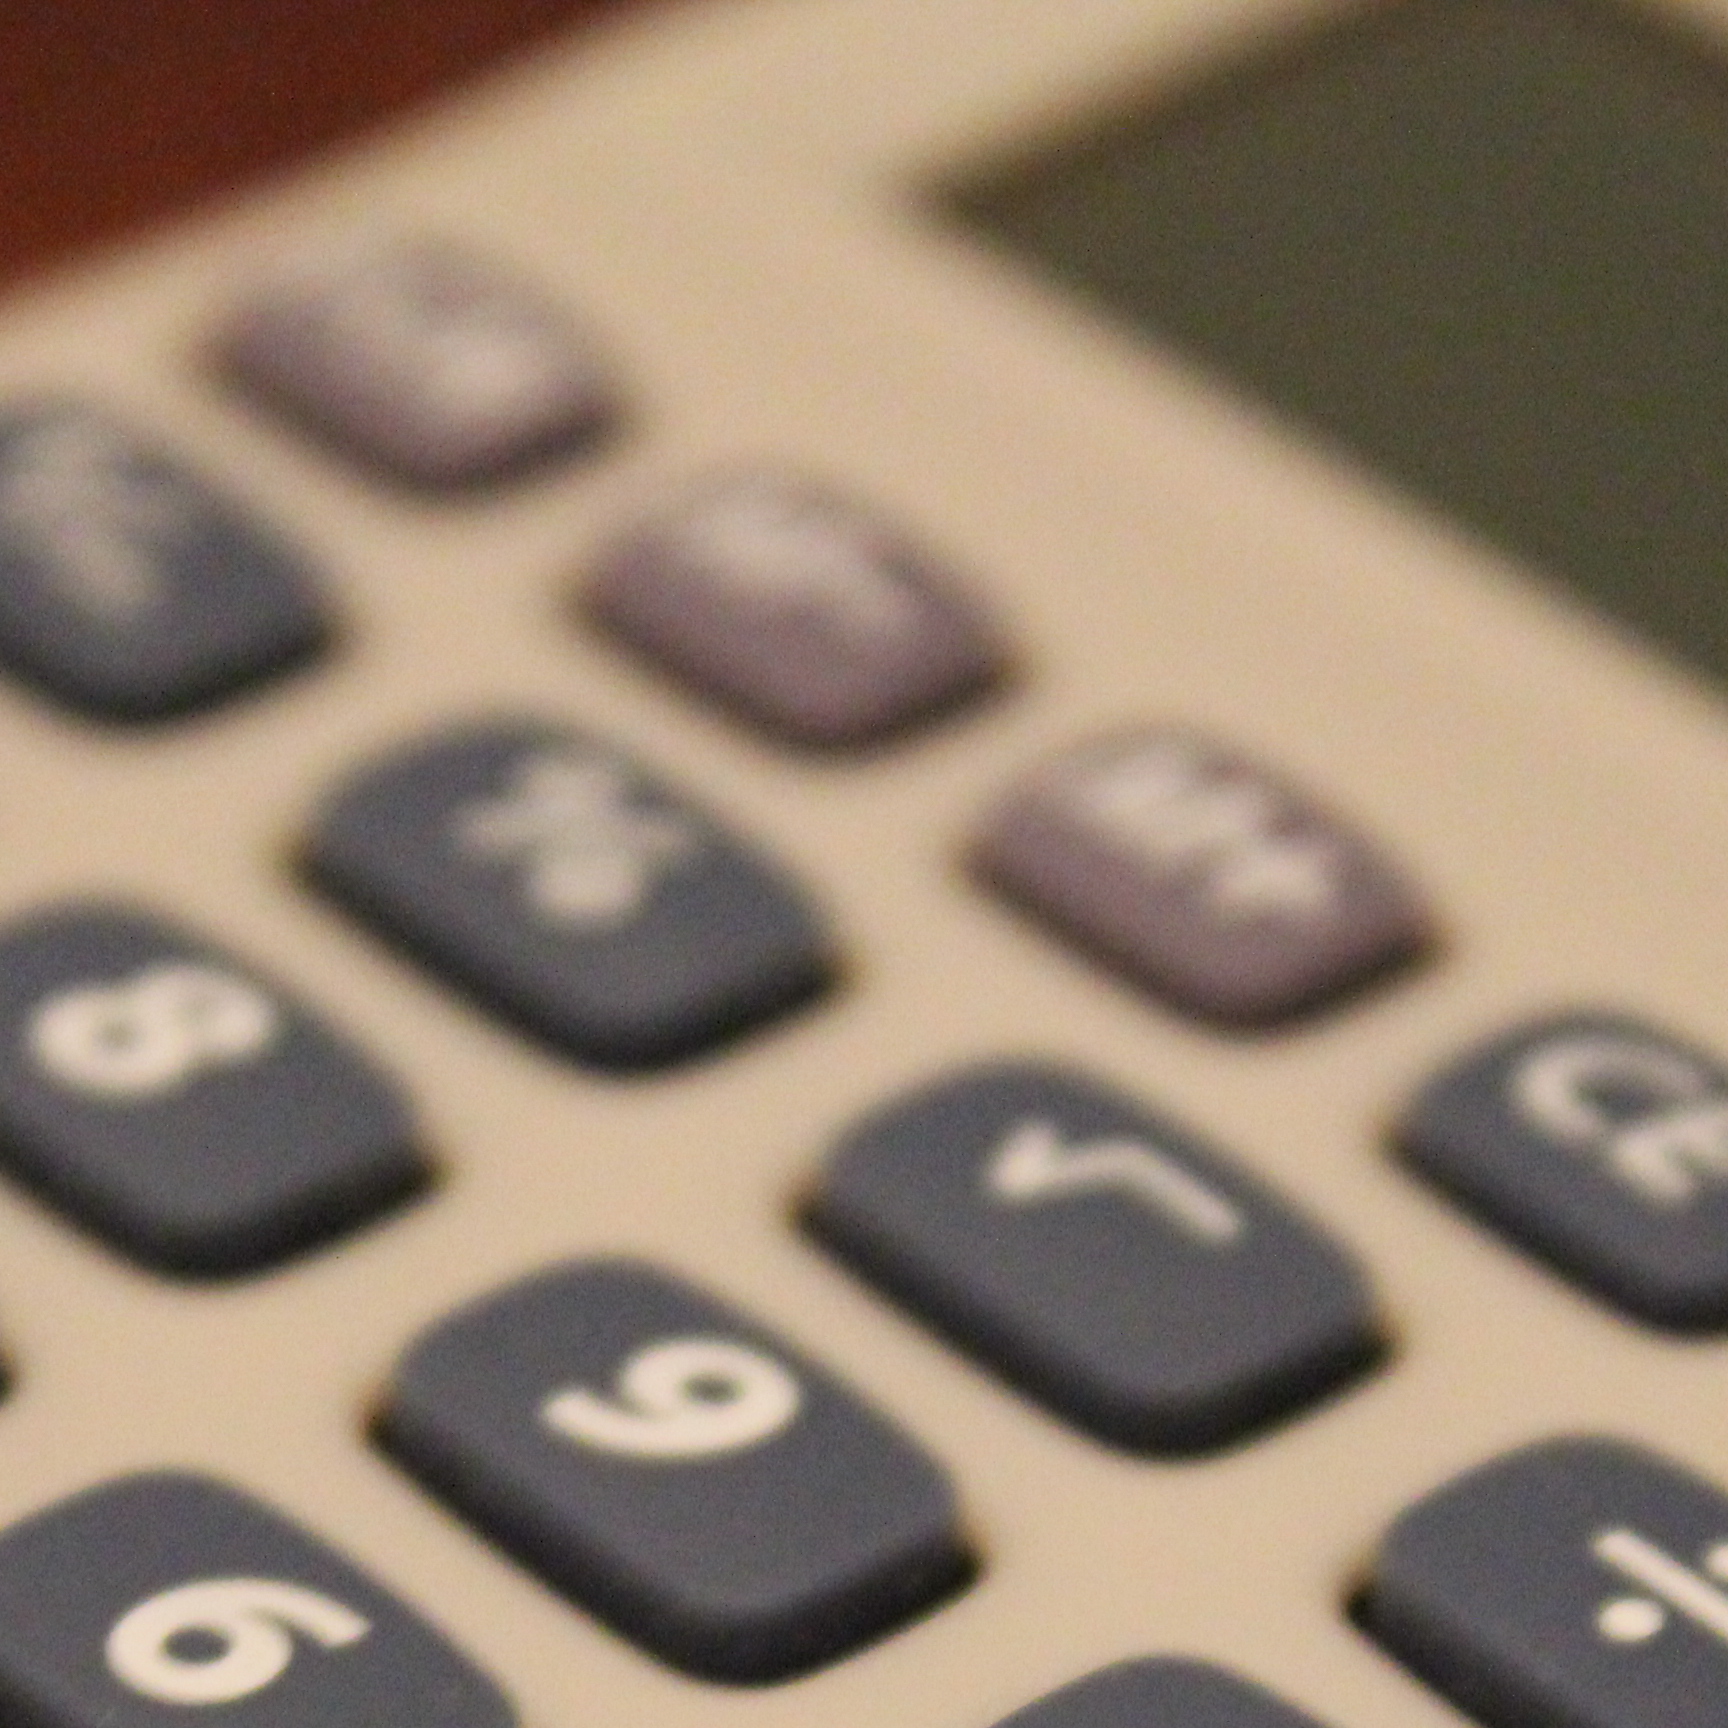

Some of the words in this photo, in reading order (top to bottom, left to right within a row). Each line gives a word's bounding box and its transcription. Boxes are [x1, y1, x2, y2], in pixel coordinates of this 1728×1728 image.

[26, 958, 275, 1097] 8
[540, 1336, 802, 1460] 9
[102, 1575, 370, 1707] 6
